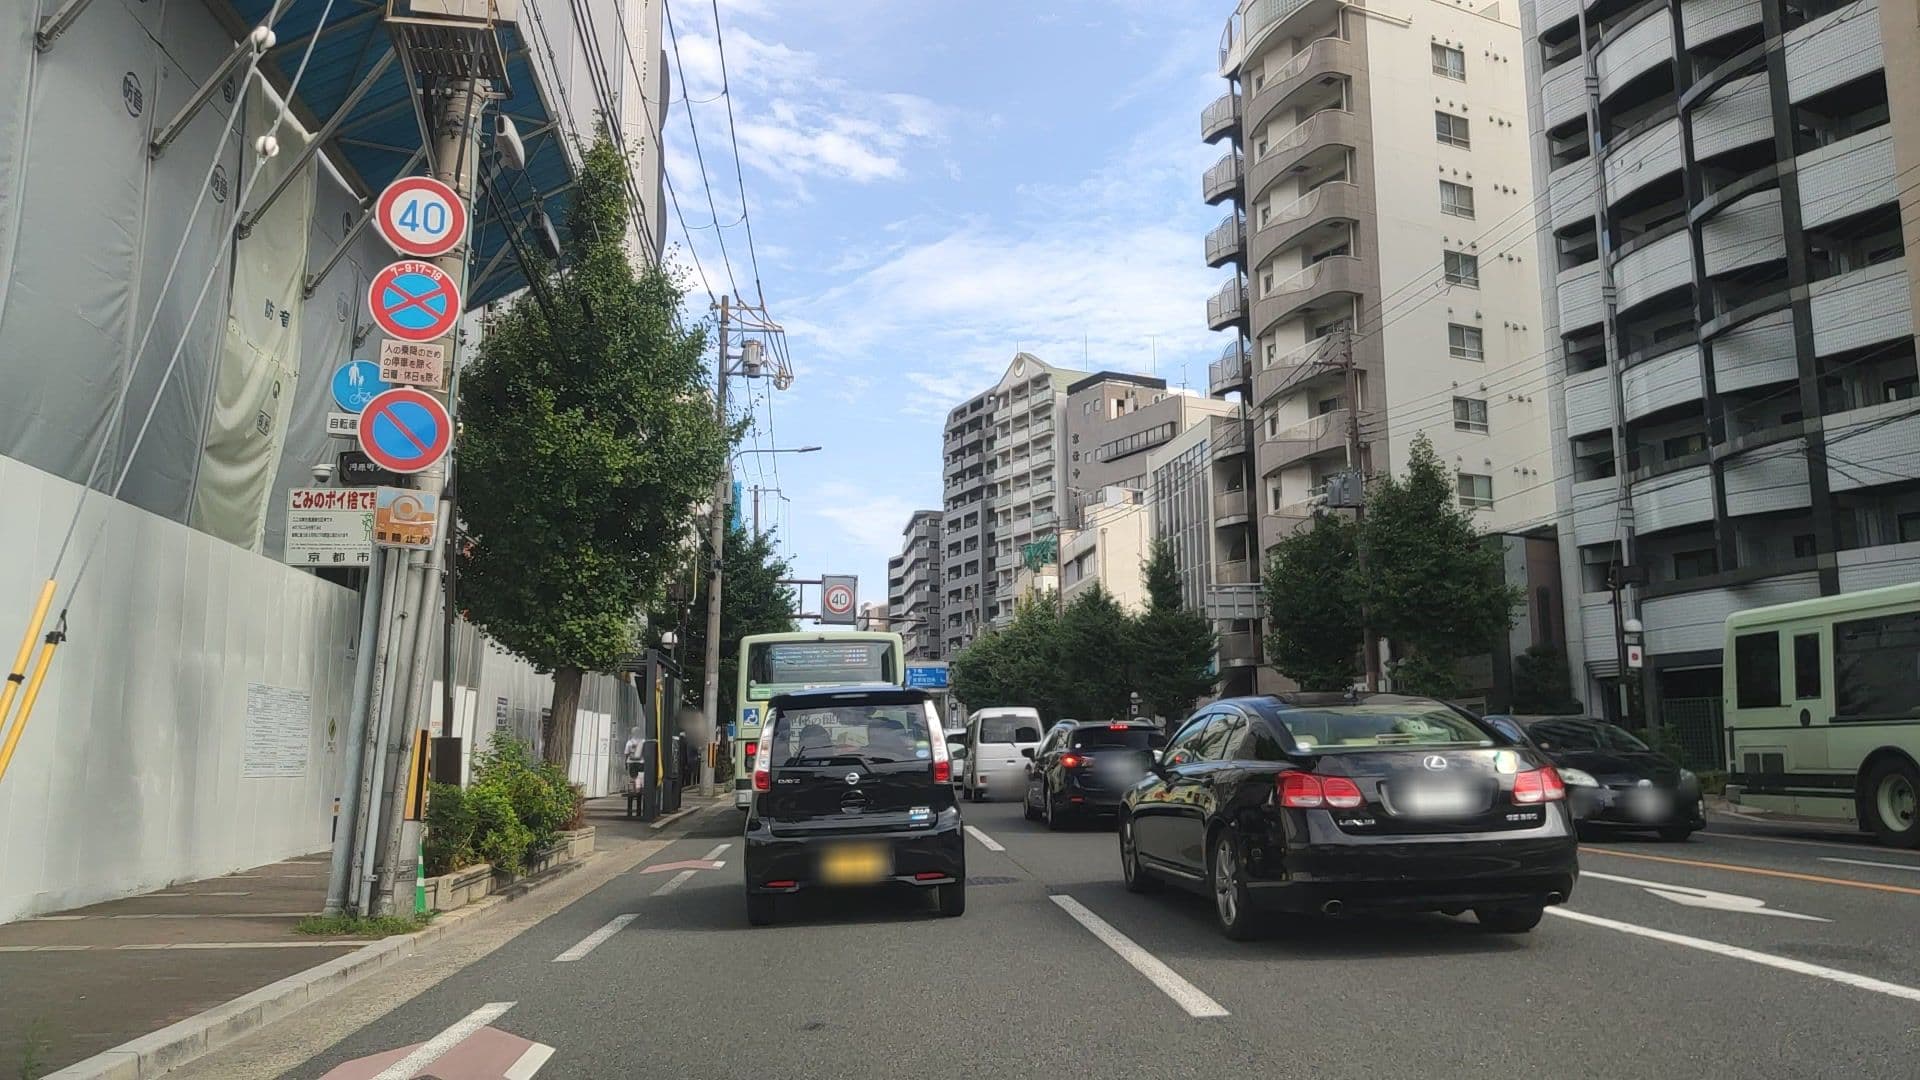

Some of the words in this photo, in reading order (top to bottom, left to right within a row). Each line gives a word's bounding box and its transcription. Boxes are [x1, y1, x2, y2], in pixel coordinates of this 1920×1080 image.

[398, 200, 446, 235] 40
[264, 298, 290, 328] 防音
[383, 357, 432, 370] の停車を除く
[307, 552, 370, 563] 京都市
[831, 593, 847, 606] 40
